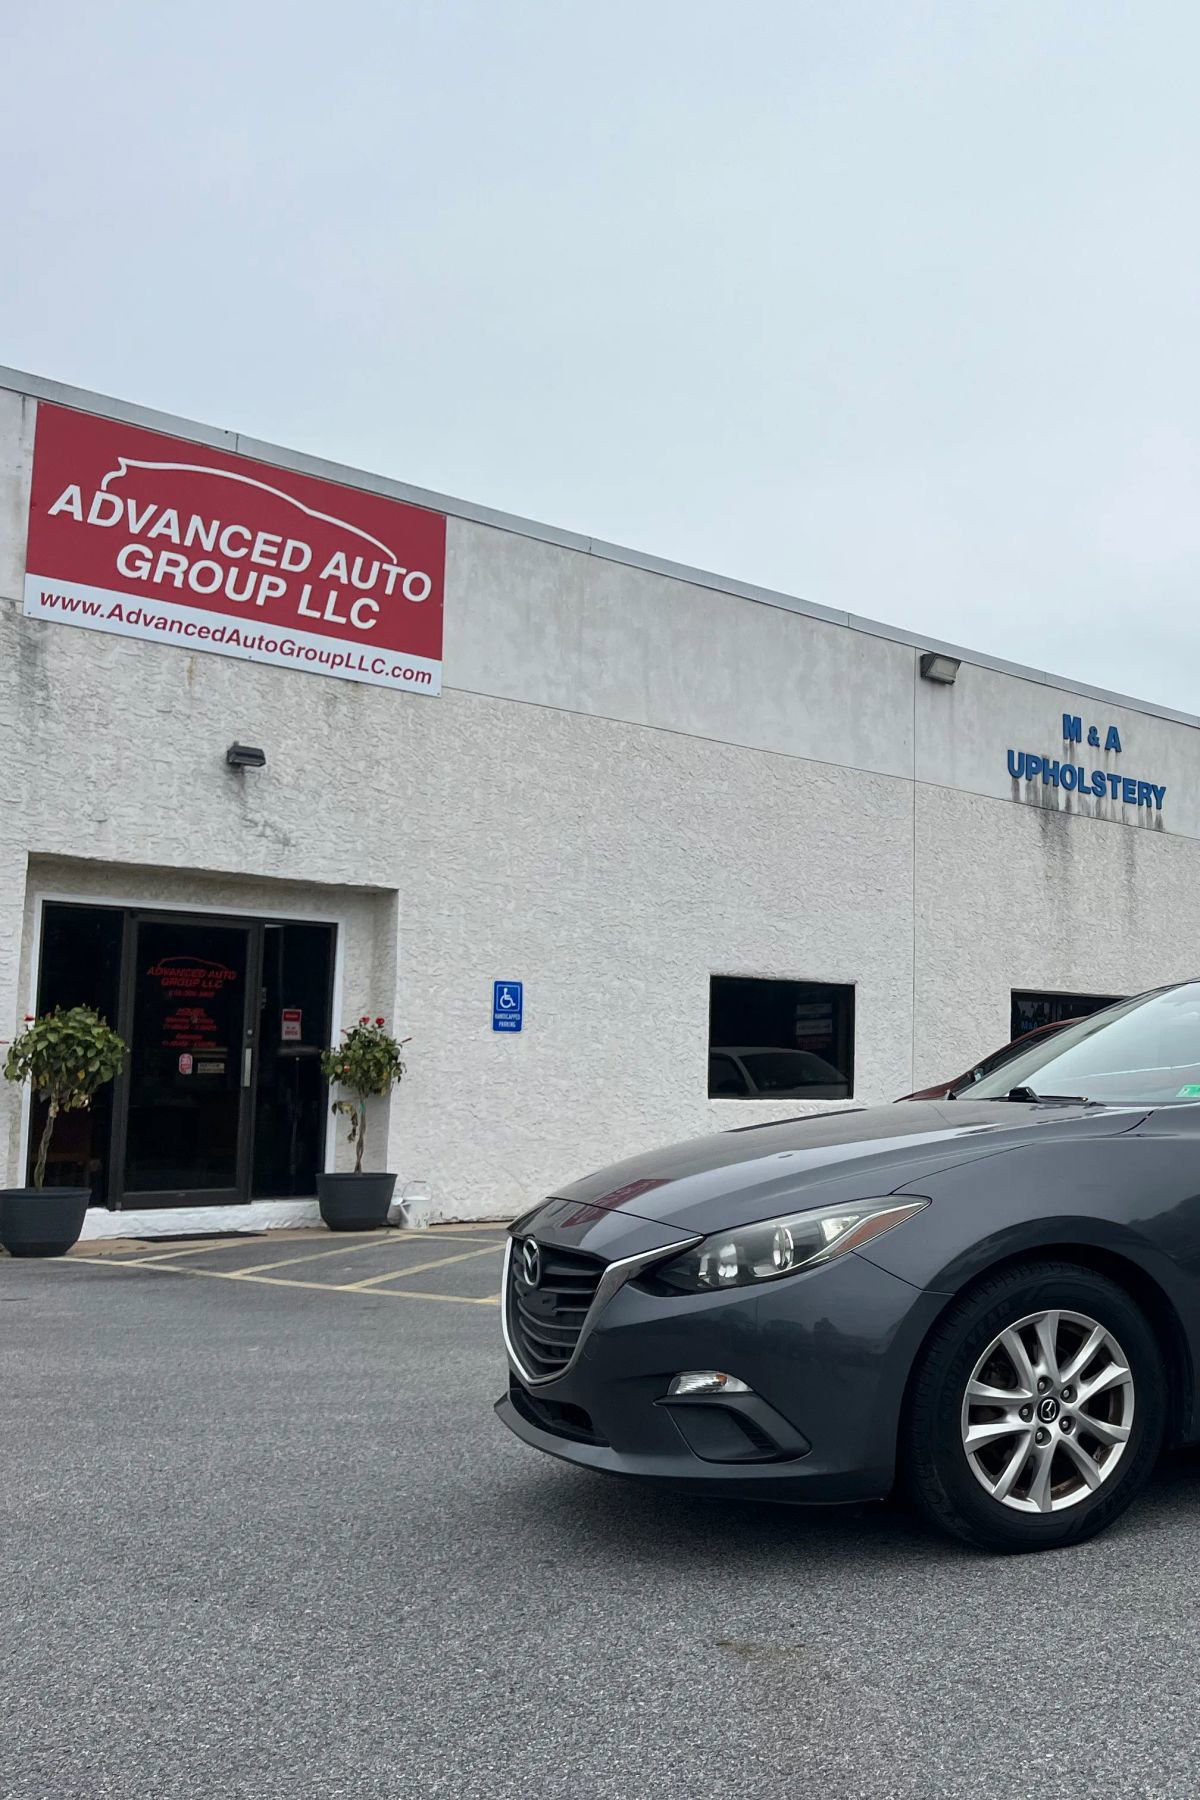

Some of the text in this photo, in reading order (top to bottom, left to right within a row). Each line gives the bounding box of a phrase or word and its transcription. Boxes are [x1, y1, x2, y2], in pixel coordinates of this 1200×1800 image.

[47, 485, 432, 602] ADVANCED AUTO
[116, 543, 380, 630] GROUP LLC
[40, 590, 433, 685] www.AdvancedAutoGroupLLC.com
[1062, 713, 1122, 752] M & A
[1007, 749, 1167, 809] UPHOLSTERY
[147, 967, 237, 980] ADVANCED AUTO
[161, 977, 200, 987] GROUP
